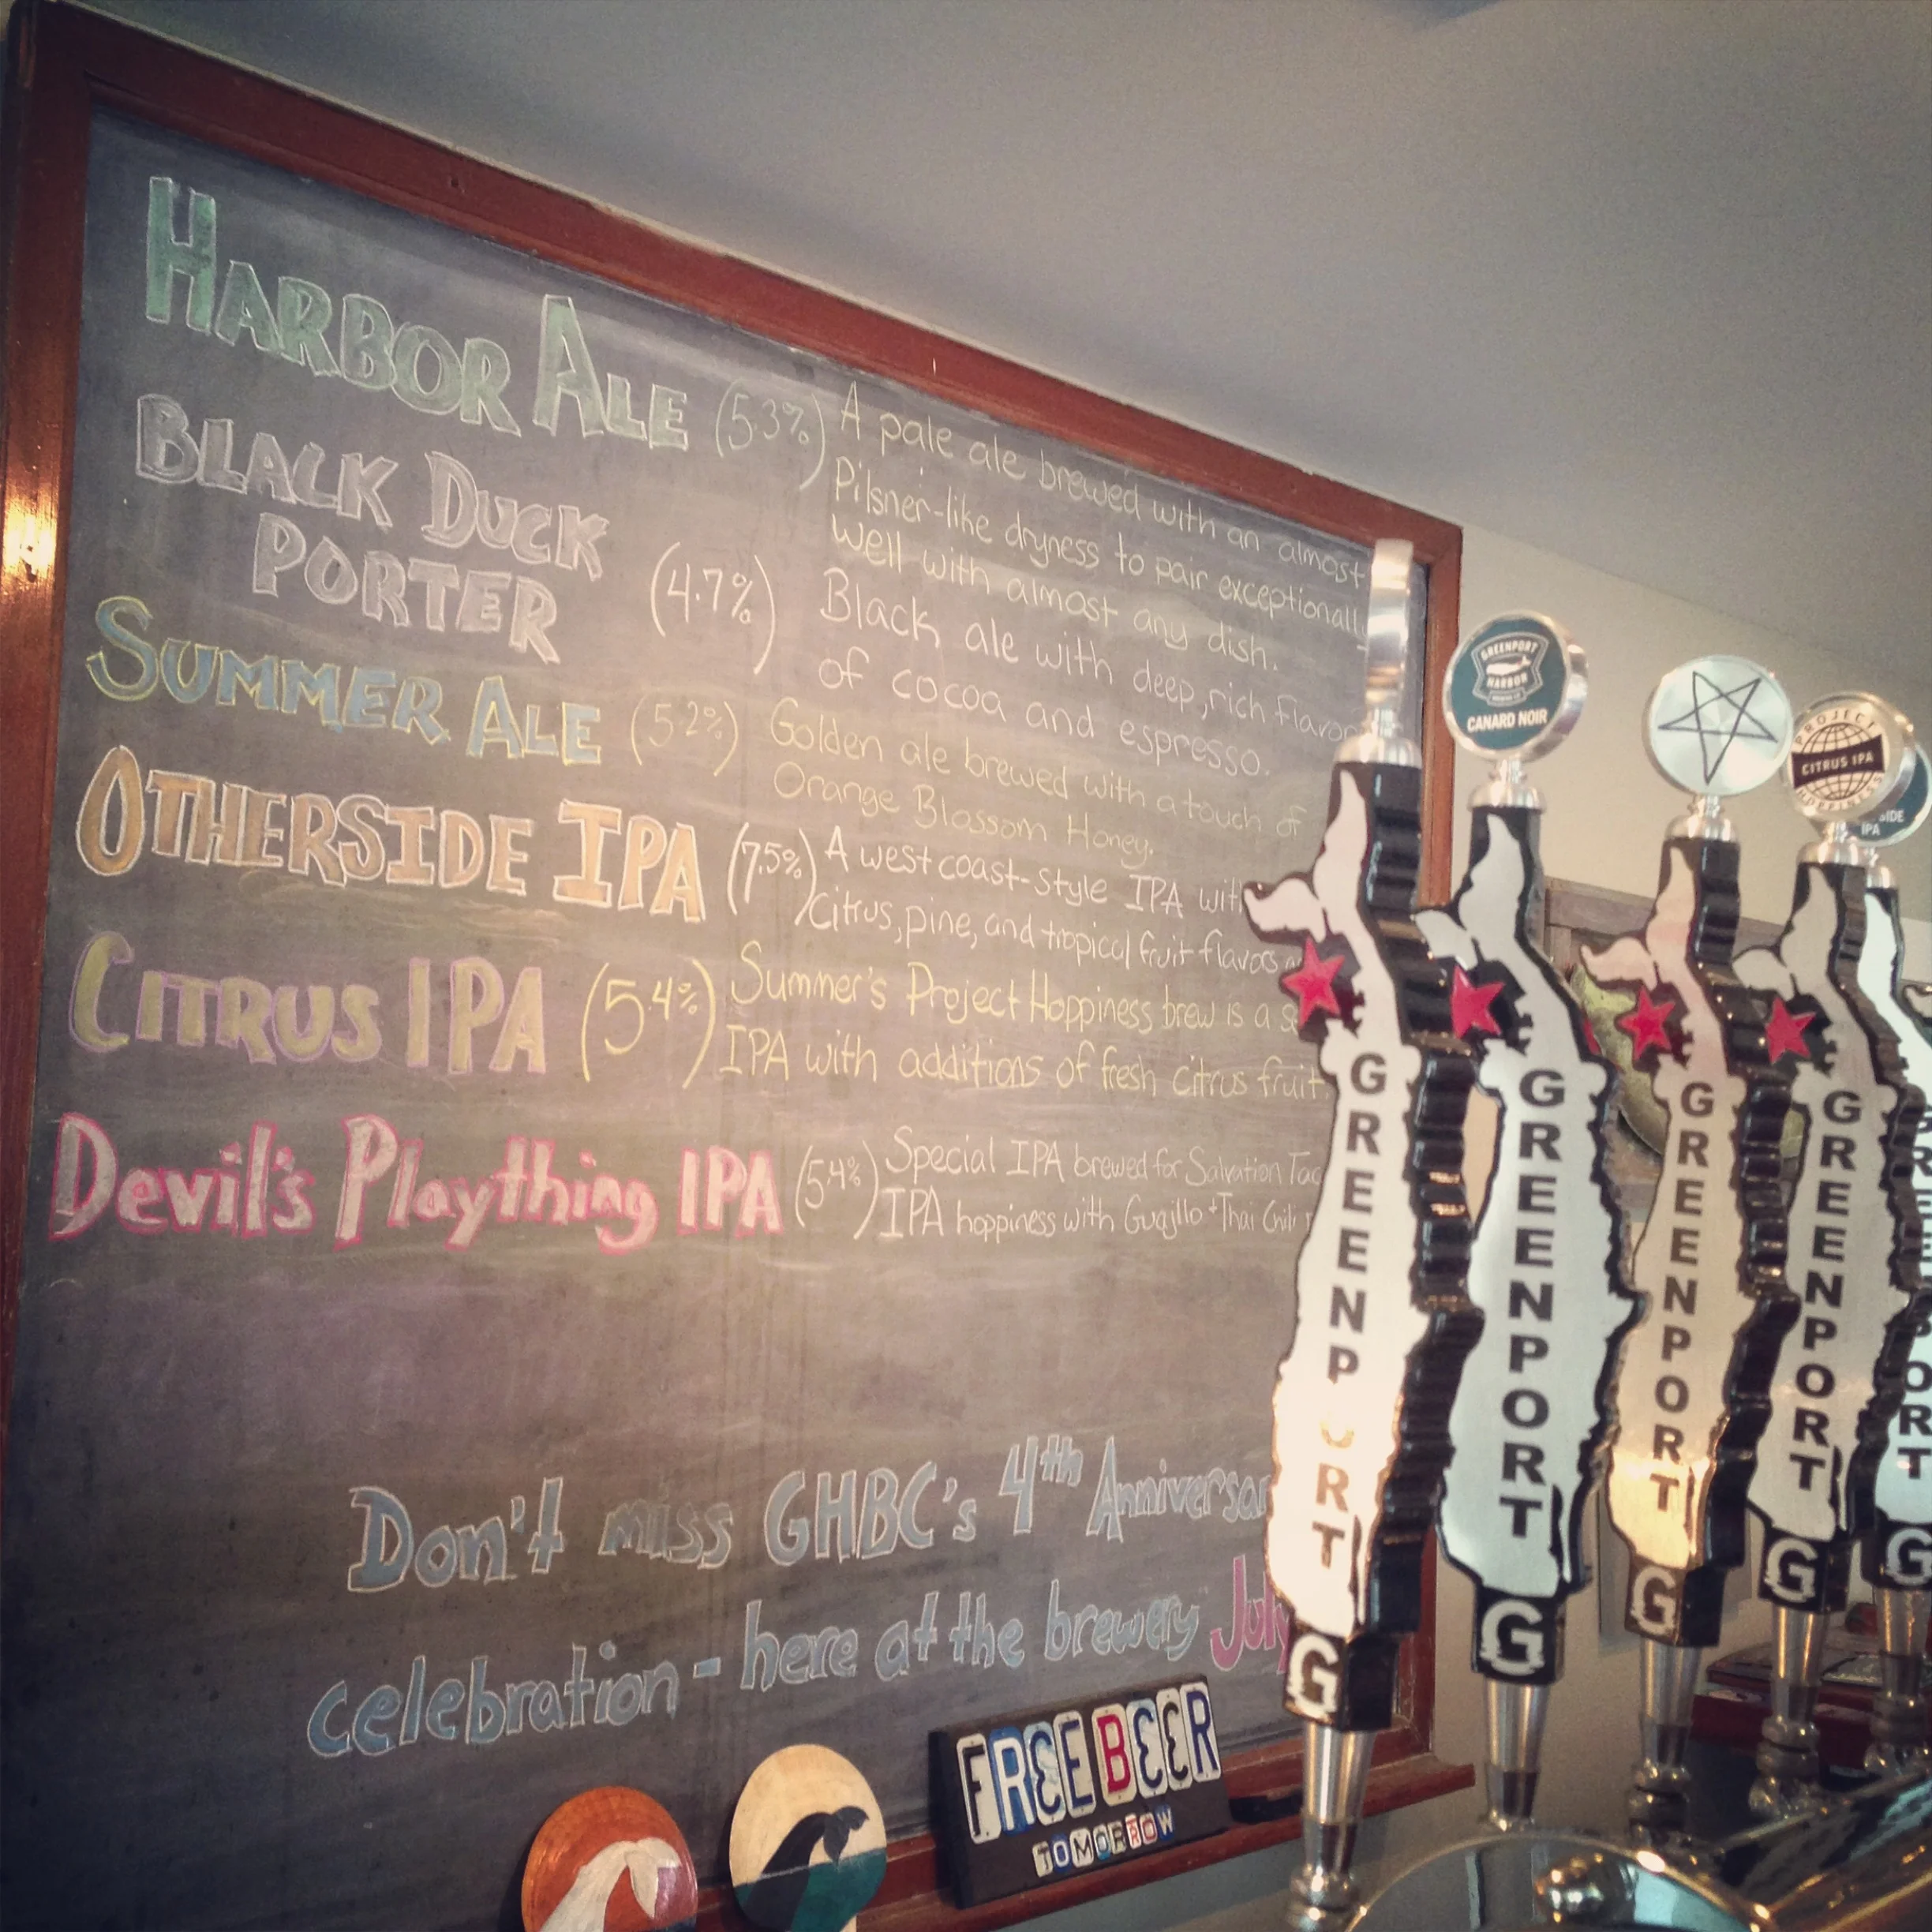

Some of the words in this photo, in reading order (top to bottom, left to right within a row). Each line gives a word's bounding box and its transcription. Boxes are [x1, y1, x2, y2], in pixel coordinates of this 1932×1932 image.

[146, 176, 521, 436] HARBOR
[136, 393, 399, 530] BLACK
[841, 380, 860, 440] A
[879, 413, 953, 458] pale
[969, 434, 1025, 480] ale
[1039, 449, 1141, 521] brewed
[1153, 499, 1215, 538] with
[1227, 526, 1260, 551] an
[1278, 540, 1365, 589] almost
[253, 512, 560, 665] PORTER
[651, 541, 775, 674] (4.7%)
[923, 547, 990, 593] with
[1007, 578, 1118, 627] almost
[1133, 608, 1188, 650] any
[1208, 621, 1279, 672] dish.
[1005, 511, 1099, 568] dryness
[1115, 532, 1144, 575] to
[1155, 555, 1208, 590] pair
[87, 595, 451, 746] SUMMER
[819, 567, 940, 648] Black
[965, 618, 1018, 664] ale
[1036, 631, 1113, 685] with
[1481, 640, 1538, 661] GREENPORT
[770, 696, 882, 762] Golden
[900, 731, 950, 775] ale
[965, 736, 1068, 799] brewed
[1084, 770, 1145, 808] with
[1276, 805, 1307, 837] of
[819, 646, 869, 689] of
[893, 668, 1006, 722] cocoa
[1026, 702, 1095, 738] and
[1119, 719, 1269, 777] espresso.
[1466, 712, 1515, 732] CANARD
[1518, 708, 1548, 726] NOIR
[1801, 756, 1848, 777] CITRUS
[1852, 751, 1874, 766] IPA
[76, 745, 535, 895] OTHERSIDE
[553, 798, 706, 921] IPA
[774, 762, 900, 817] Orange
[914, 784, 1047, 842] Blossom
[1068, 813, 1154, 868] Honey.
[825, 825, 848, 872] A
[860, 844, 931, 874] west
[1124, 874, 1183, 918] IPA
[1861, 823, 1881, 836] IPA
[732, 940, 887, 1011] Summer's
[906, 961, 1020, 1024] Project
[1030, 968, 1152, 1034] Hoppiness
[1163, 984, 1215, 1029] brew
[1227, 1001, 1244, 1027] is
[1255, 1003, 1270, 1030] a
[985, 912, 1034, 948] and
[1041, 919, 1130, 969] tropical
[1140, 930, 1194, 968] fruit
[69, 931, 381, 1065] CITRUS
[406, 957, 546, 1074] IPA
[582, 957, 716, 1089] (5.4%)
[719, 1024, 789, 1081] IPA
[806, 1029, 877, 1082] with
[899, 1039, 1044, 1088] additions
[1056, 1041, 1095, 1089] of
[1101, 1046, 1157, 1096] fresh
[1172, 1055, 1248, 1098] citrus
[48, 1113, 314, 1241] Devil's
[334, 1113, 657, 1257] Plaything
[676, 1144, 784, 1239] IPA
[879, 1185, 944, 1238] IPA
[957, 1200, 1056, 1244] hoppiness
[1064, 1194, 1114, 1233] with
[886, 1125, 995, 1184] Special
[1006, 1139, 1065, 1183] IPA
[1073, 1143, 1148, 1181] brewed
[1151, 1147, 1183, 1179] for
[1185, 1146, 1282, 1187] Salvation
[1498, 1067, 1566, 1538] GREENPORT
[1650, 1081, 1714, 1513] GREENPORT
[1788, 1089, 1862, 1491] GREENPORT
[347, 1476, 564, 1593] Don't
[597, 1498, 734, 1571] miss
[763, 1460, 977, 1567] GHBC's
[998, 1434, 1083, 1536] 4th
[1764, 1537, 1819, 1603] G
[1886, 1527, 1932, 1586] G
[307, 1640, 679, 1758] celebration
[739, 1599, 859, 1692] here
[874, 1590, 940, 1683] at
[948, 1591, 1025, 1670] the
[1044, 1578, 1200, 1661] brewery
[1210, 1555, 1290, 1674] July
[1480, 1600, 1544, 1676] G
[1631, 1567, 1676, 1636] G
[1282, 1632, 1342, 1719] G
[960, 1718, 1095, 1837] FREE
[1096, 1690, 1219, 1793] BEER
[1035, 1807, 1174, 1873] TOMORROW
